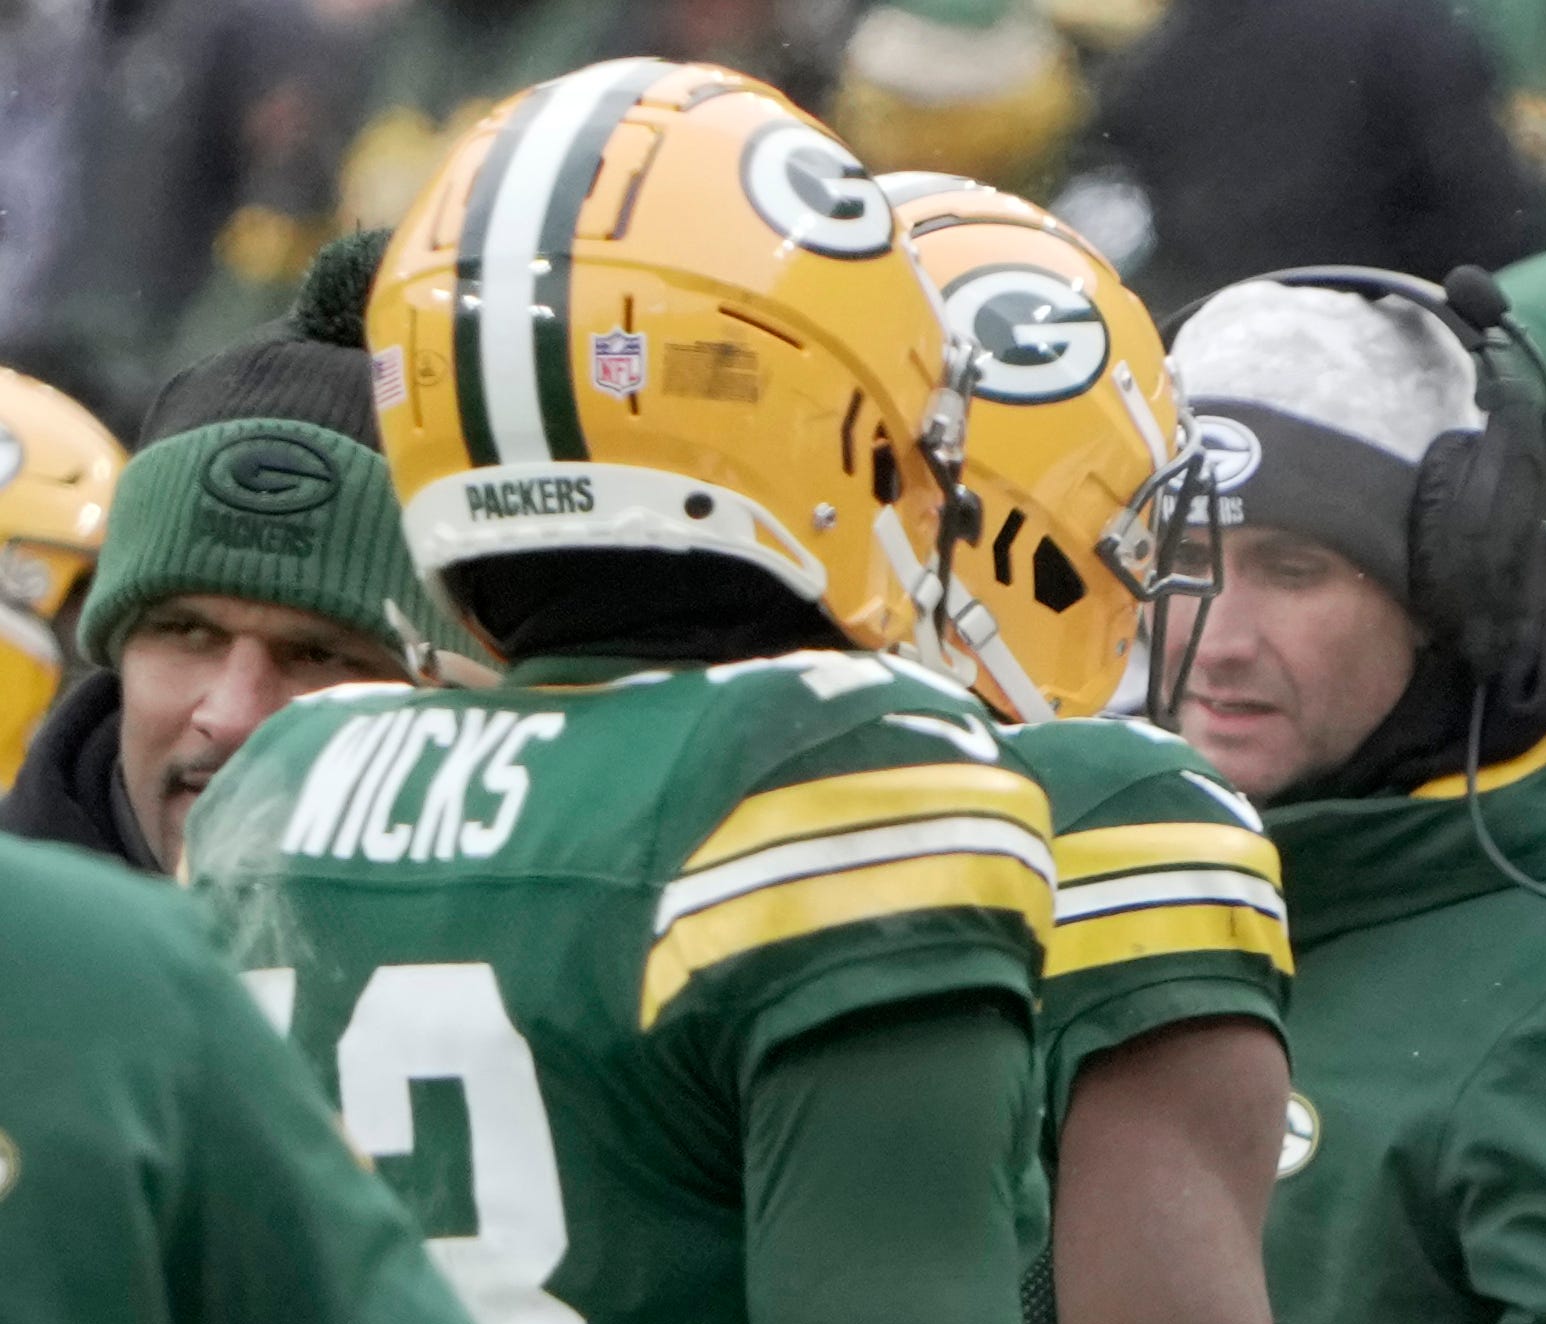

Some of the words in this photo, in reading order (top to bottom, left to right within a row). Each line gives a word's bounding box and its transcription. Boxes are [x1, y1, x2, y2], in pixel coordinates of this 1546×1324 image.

[750, 125, 894, 251] G
[944, 269, 1107, 394] G
[205, 436, 340, 513] G
[465, 476, 594, 520] PACKERS
[281, 707, 566, 862] WICKS
